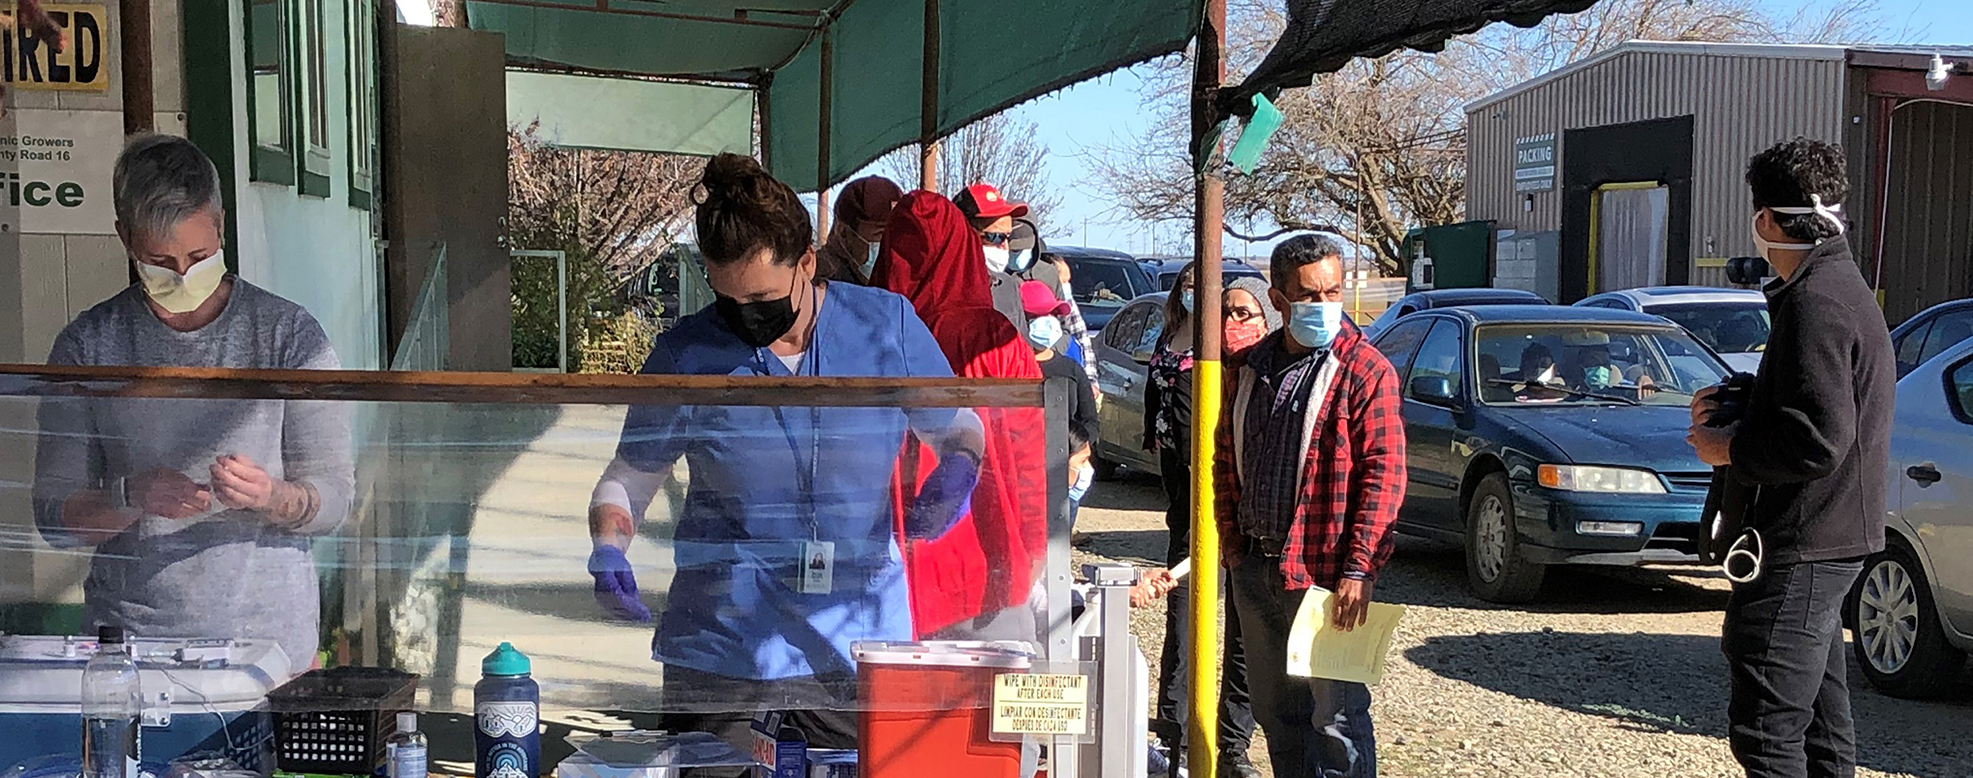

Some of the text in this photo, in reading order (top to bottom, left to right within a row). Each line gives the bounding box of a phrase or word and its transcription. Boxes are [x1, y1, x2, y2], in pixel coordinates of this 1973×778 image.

[22, 135, 74, 147] Growers
[20, 150, 52, 160] Road
[56, 151, 70, 161] 16
[1518, 146, 1552, 164] PACKING
[1004, 675, 1081, 688] WIPE WITH DISINFECTANT
[1017, 688, 1064, 699] AFTER EACH USE
[1001, 705, 1081, 719] LIMPIAR CON DESINFECTANTE
[1036, 720, 1042, 730] DE
[1058, 720, 1067, 731] USO
